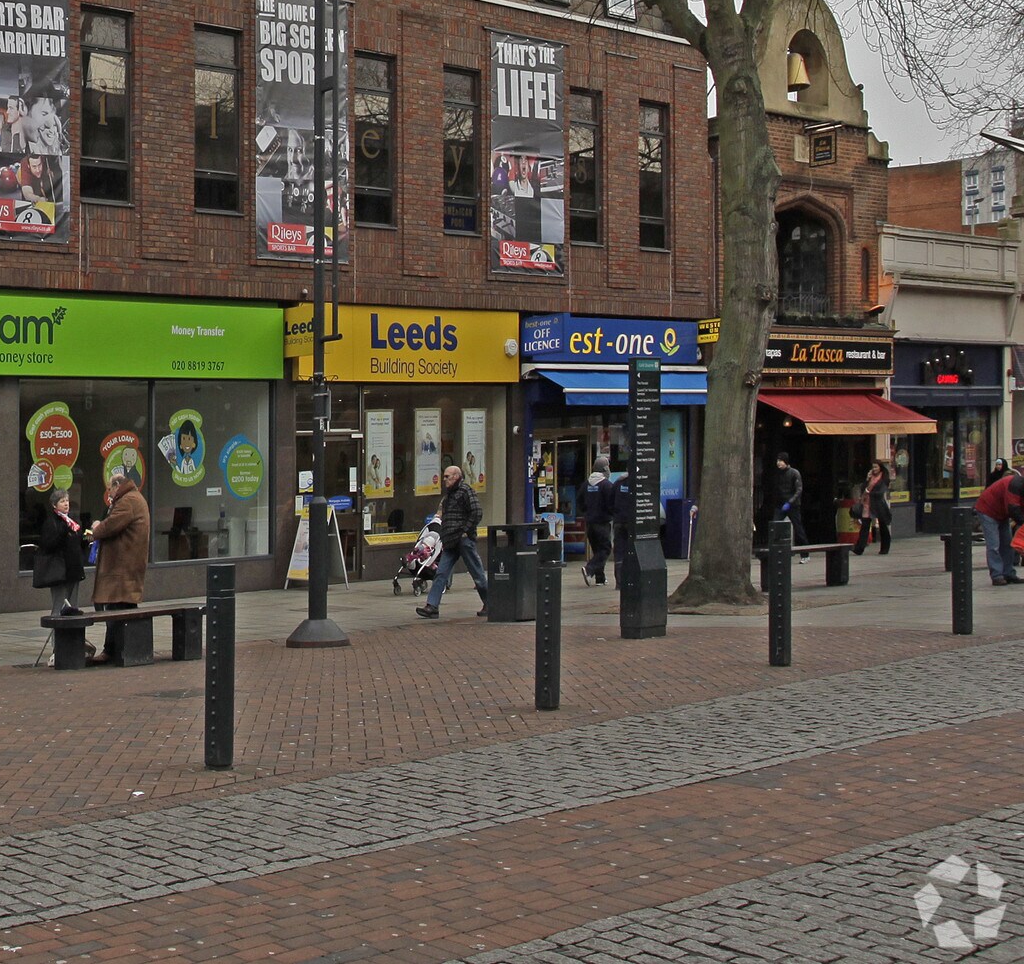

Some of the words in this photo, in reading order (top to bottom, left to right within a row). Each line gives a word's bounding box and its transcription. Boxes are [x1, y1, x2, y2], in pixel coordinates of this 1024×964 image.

[31, 5, 64, 31] BAR
[278, 2, 308, 22] HOME
[259, 20, 286, 46] BIG
[496, 42, 536, 67] THAT'S
[539, 46, 555, 64] THE
[260, 48, 327, 86] SPOR
[497, 68, 556, 120] LIFE!
[272, 225, 302, 242] Rileys
[172, 325, 195, 338] Money
[197, 326, 225, 336] Transfer
[285, 318, 314, 335] Leed
[371, 313, 457, 351] Leeds
[525, 320, 551, 328] best-one
[534, 328, 550, 339] OFF
[524, 339, 560, 352] LICENCE
[791, 344, 807, 362] La
[810, 342, 844, 363] Tasca
[846, 350, 871, 359] restaurant
[872, 350, 876, 359] &
[877, 351, 886, 359] bar
[27, 352, 53, 363] store
[172, 360, 185, 370] 020
[188, 361, 205, 371] 8819
[208, 362, 224, 371] 3767
[371, 358, 414, 378] Building
[418, 358, 457, 378] Society
[40, 430, 72, 438] £50-£500
[40, 447, 55, 455] 5-60
[57, 447, 72, 456] days
